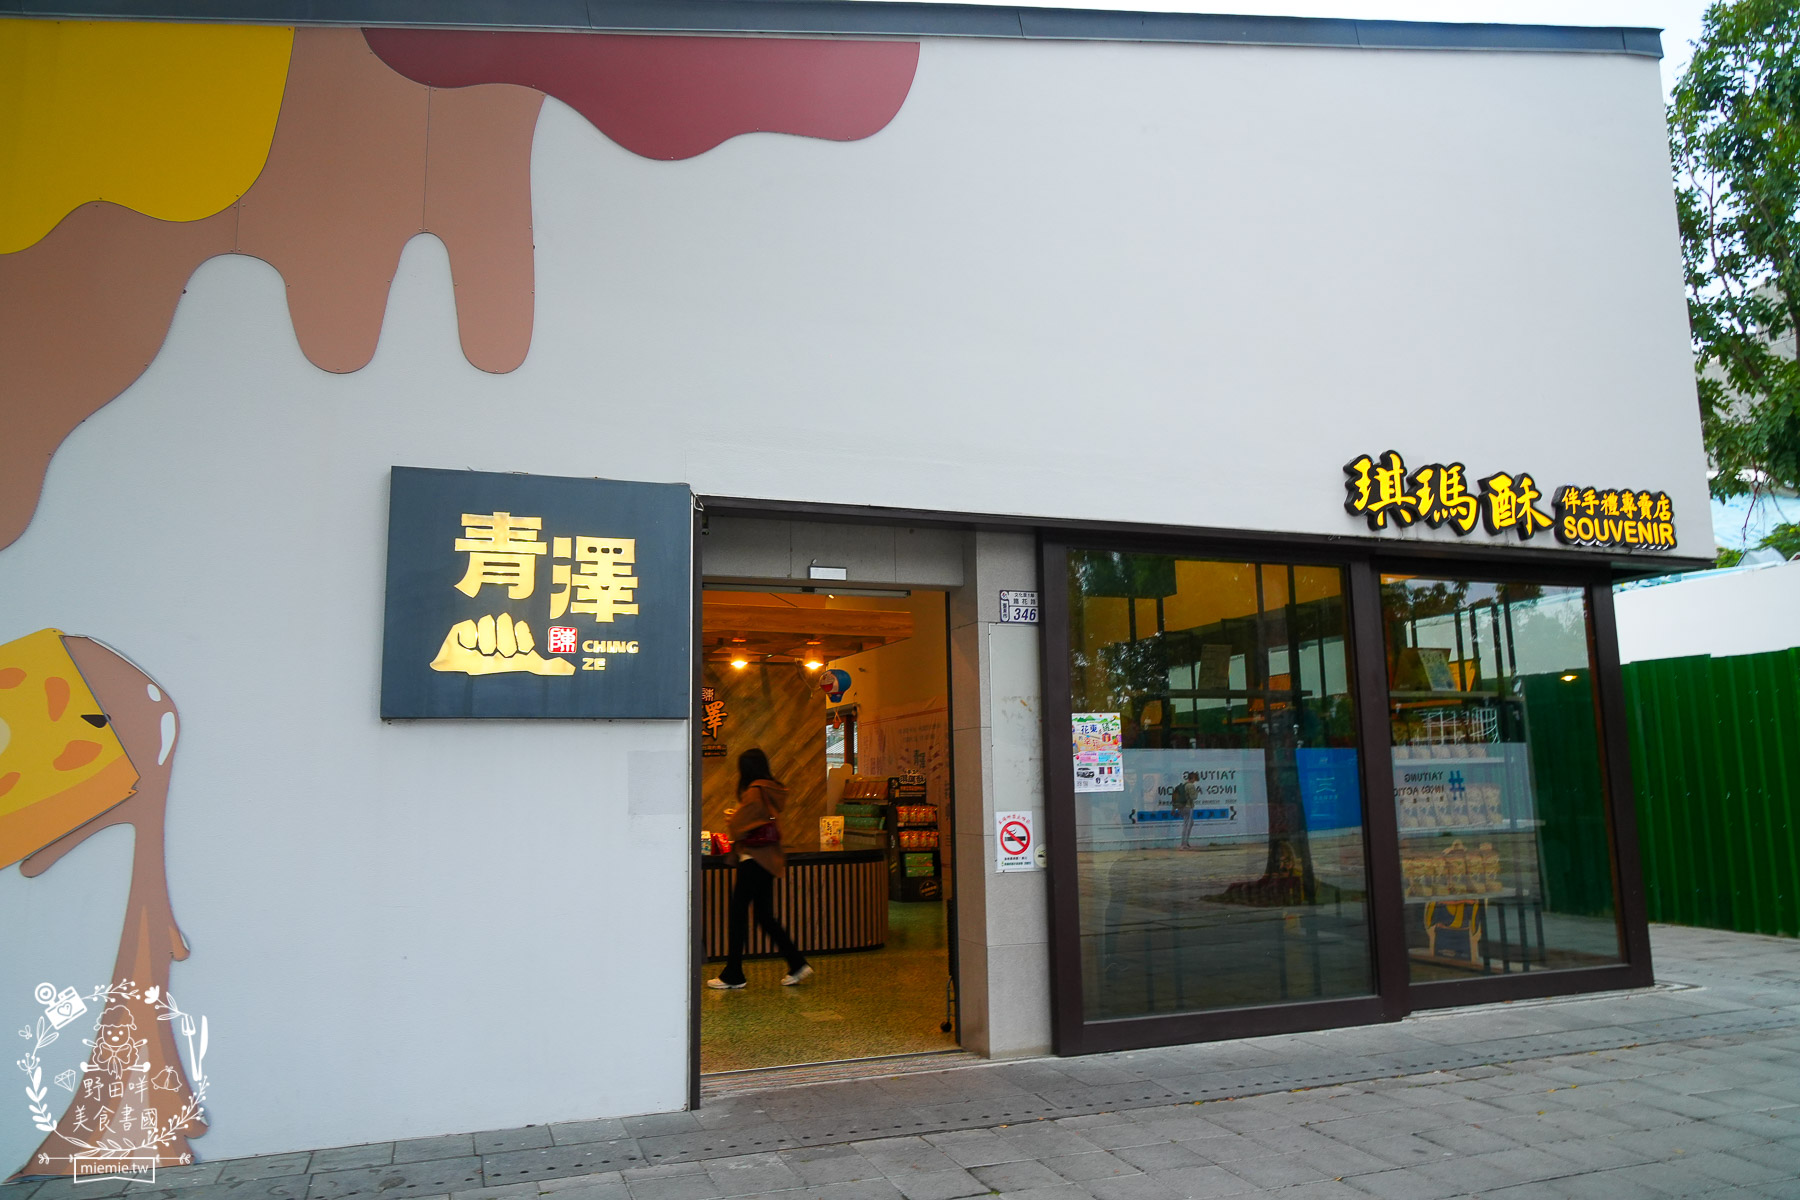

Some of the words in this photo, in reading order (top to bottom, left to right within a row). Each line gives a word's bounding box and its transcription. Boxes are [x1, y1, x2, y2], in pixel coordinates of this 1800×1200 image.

[1352, 453, 1553, 535] 琪瑪酥
[1562, 487, 1674, 520] 伴手禮專賣店
[1563, 516, 1677, 547] SOUVENIR
[453, 511, 640, 623] 青澤
[1013, 608, 1037, 621] 346
[582, 639, 640, 654] CHING
[582, 657, 606, 671] ZE
